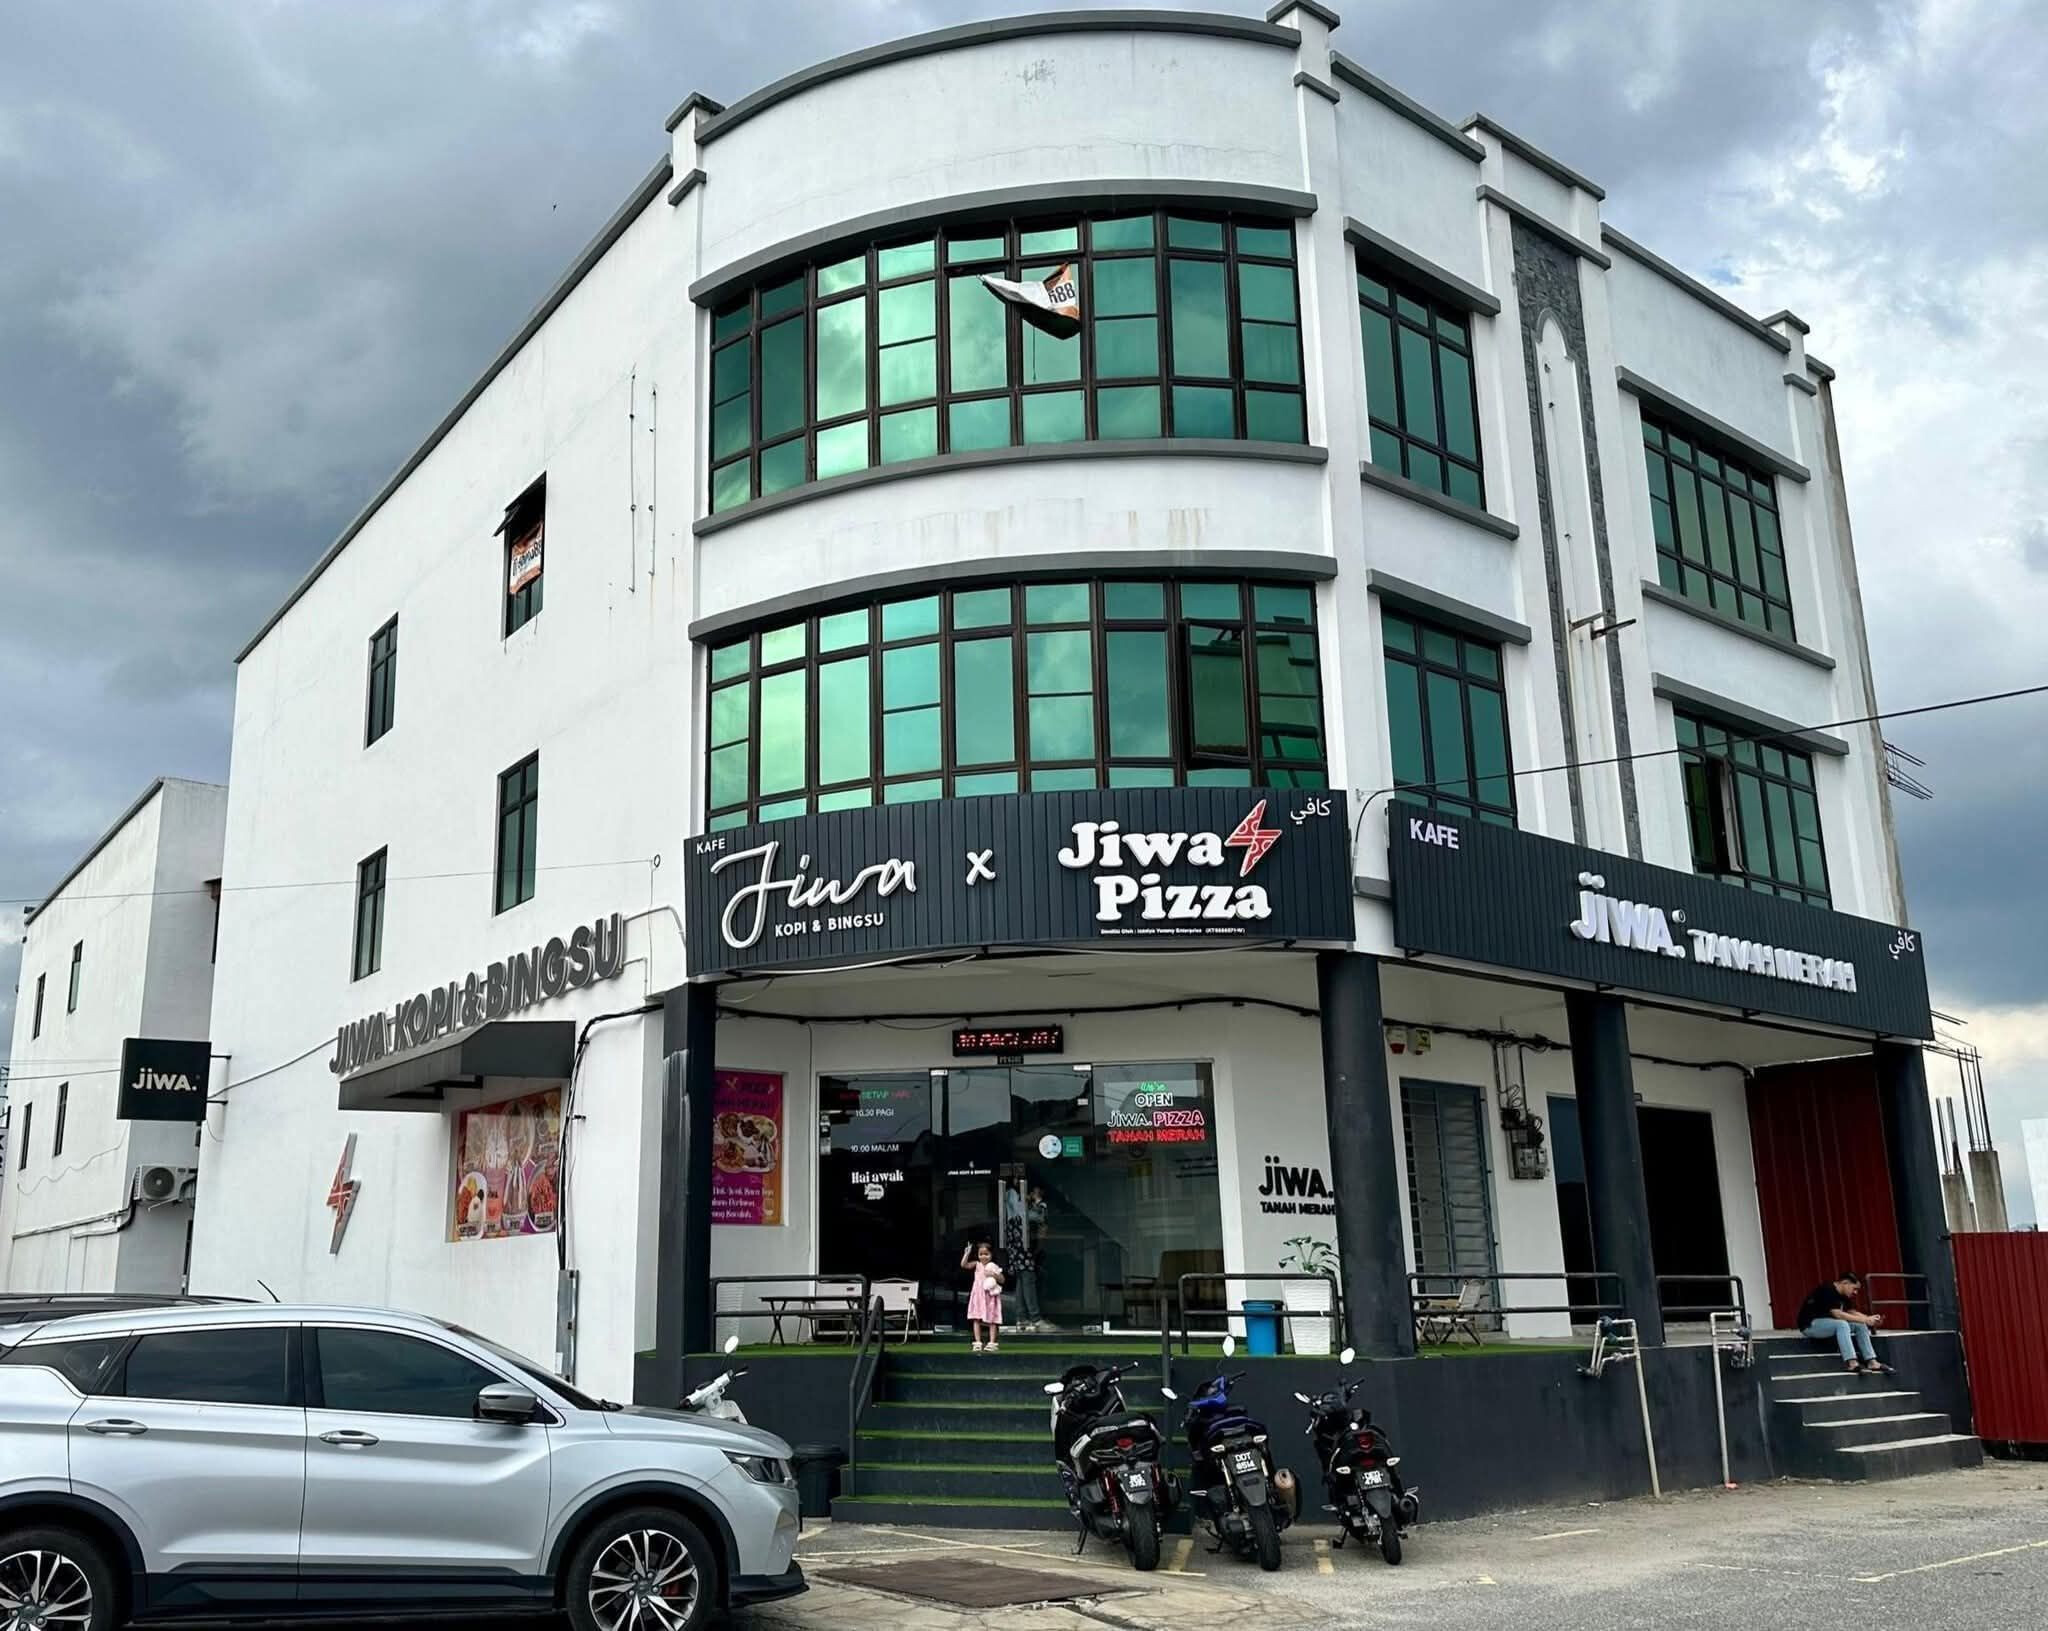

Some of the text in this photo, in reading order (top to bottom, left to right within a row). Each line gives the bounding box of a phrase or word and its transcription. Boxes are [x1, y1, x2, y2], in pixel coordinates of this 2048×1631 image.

[1290, 798, 1331, 824] كافي
[696, 838, 726, 854] KAFE
[1058, 820, 1225, 868] Jiwa
[1410, 818, 1459, 850] KAFE
[710, 840, 917, 949] Jiwa
[1093, 873, 1272, 922] Pizza
[775, 912, 884, 937] KOPI & BINGSU
[1889, 930, 1916, 959] كافي
[1687, 928, 1858, 993] TANAH MERAH
[393, 981, 460, 1050] KOPI
[460, 971, 486, 1026] &
[486, 912, 625, 1024] BINGSU
[875, 1108, 894, 1117] PAGI
[1135, 1093, 1174, 1107] OPEN
[1152, 1109, 1205, 1127] PIZZA
[871, 1143, 900, 1153] MALAM
[851, 1169, 904, 1185] Hai awak
[1260, 1201, 1336, 1216] TANAH MERAH
